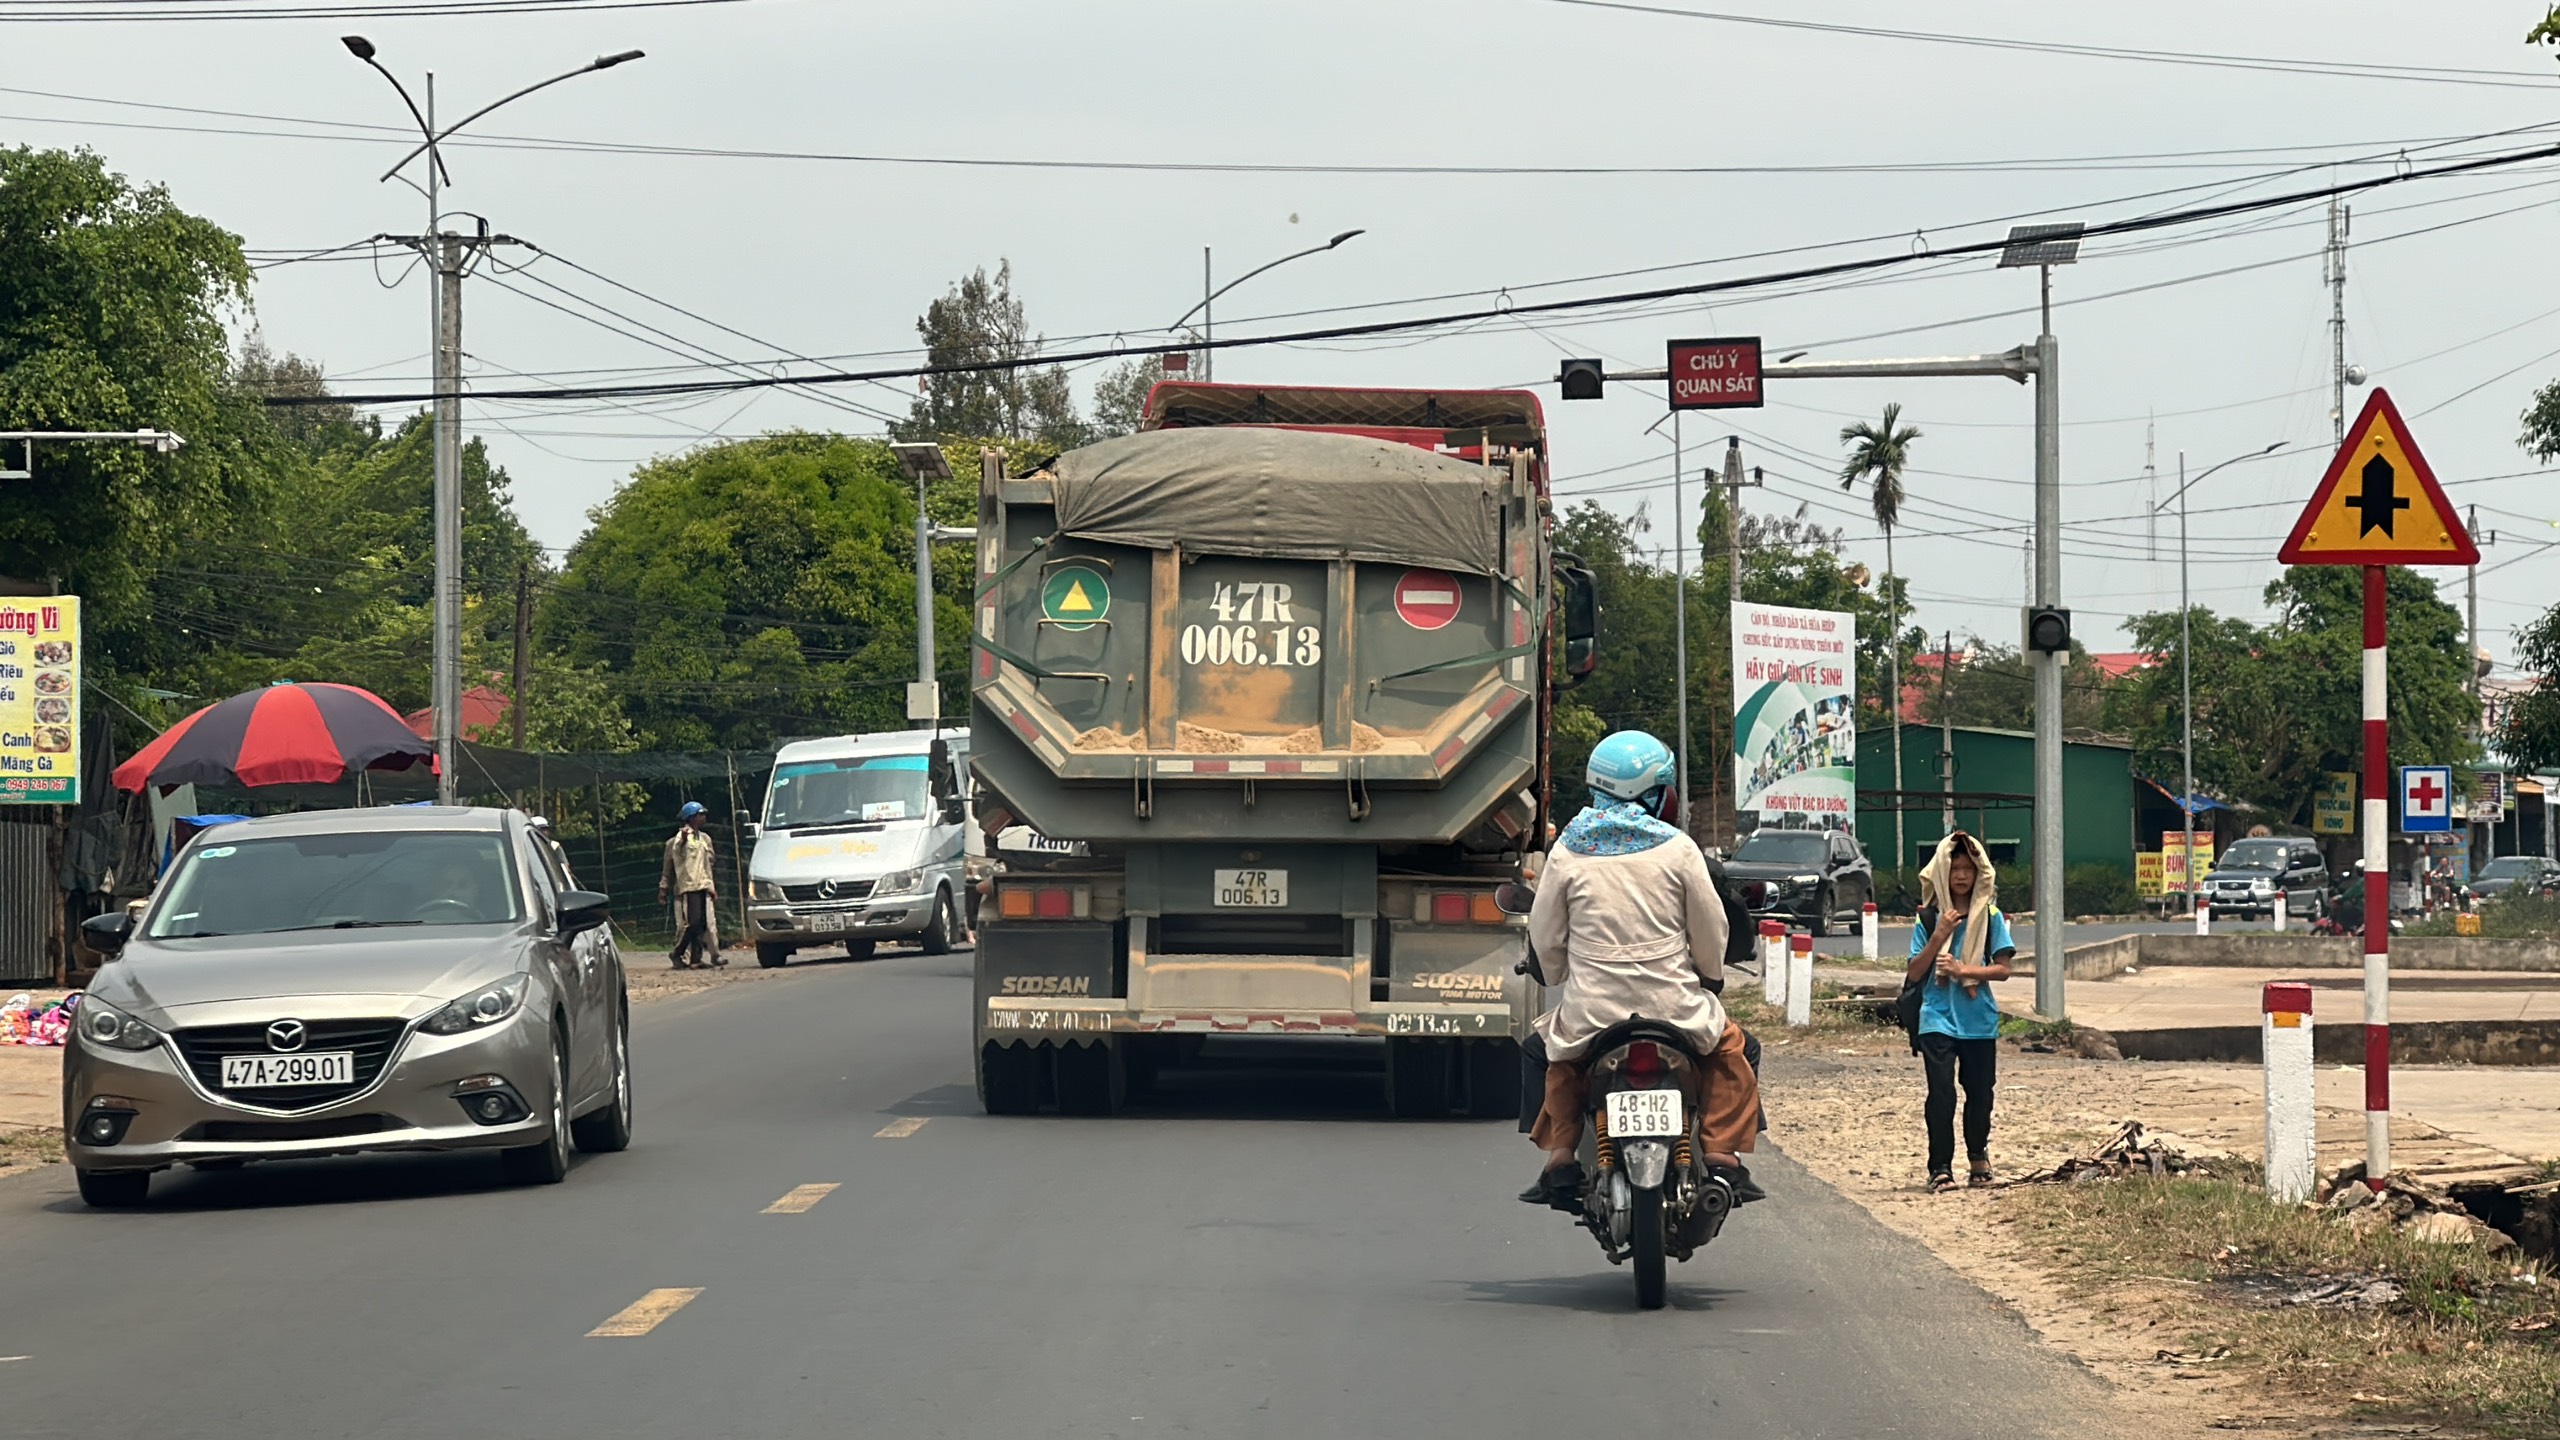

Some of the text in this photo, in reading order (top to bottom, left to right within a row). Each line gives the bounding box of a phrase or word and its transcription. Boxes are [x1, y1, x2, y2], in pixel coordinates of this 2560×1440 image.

[1690, 349, 1738, 370] CHÚ Ý
[1676, 372, 1755, 397] QUAN SÁT
[1209, 581, 1295, 622] 47R
[41, 606, 58, 629] Vi
[1181, 624, 1321, 666] 006.13
[1746, 657, 1764, 679] HÃY
[1768, 659, 1783, 681] GIỮ
[1805, 664, 1817, 687] VỆ
[1821, 667, 1842, 686] SINH
[2, 732, 32, 747] Canh
[1, 756, 33, 772] Măng
[6, 779, 28, 790] 0949
[31, 779, 48, 790] 246
[1235, 871, 1267, 887] 47R
[1222, 889, 1280, 904] 006.13
[1001, 976, 1090, 994] SOOSAN
[1412, 972, 1504, 991] SOOSAN
[1440, 990, 1503, 1000] VINA MOTOR
[227, 1056, 345, 1085] 47A-299.01
[1619, 1114, 1669, 1132] 8599
